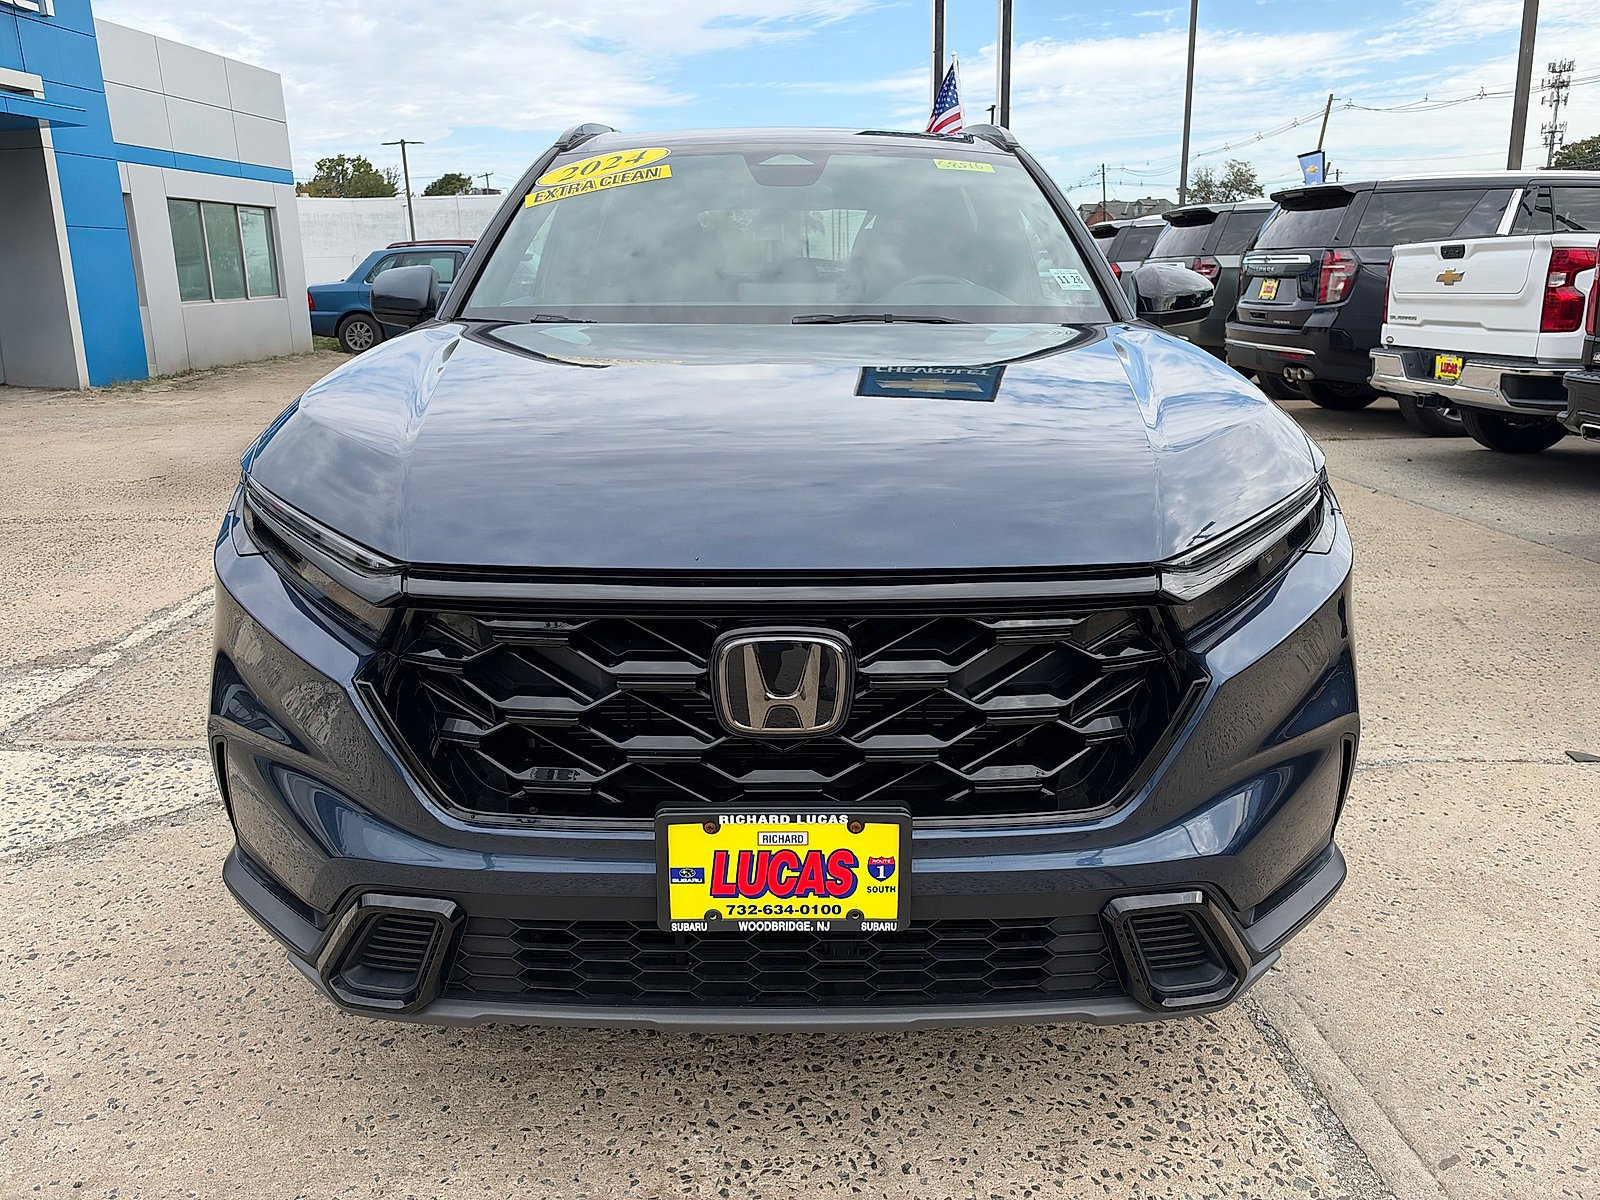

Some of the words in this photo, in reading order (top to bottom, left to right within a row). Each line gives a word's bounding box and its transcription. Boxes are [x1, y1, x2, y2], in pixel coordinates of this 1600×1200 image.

[557, 149, 648, 183] 2024
[533, 179, 597, 204] EXTRA
[599, 167, 662, 188] CLEAN
[1057, 275, 1071, 284] 11
[718, 814, 791, 825] RICHARD
[796, 814, 849, 825] LUCAS
[762, 834, 804, 844] RICHARD
[709, 848, 860, 899] LUCAS
[876, 865, 887, 879] 1
[866, 885, 896, 894] SOUTH
[726, 904, 842, 916] 732-634-0100
[671, 922, 708, 932] SUBARU
[738, 921, 814, 932] WOODBRIDGE,
[816, 921, 831, 932] NJ
[861, 922, 898, 932] SUBARU
